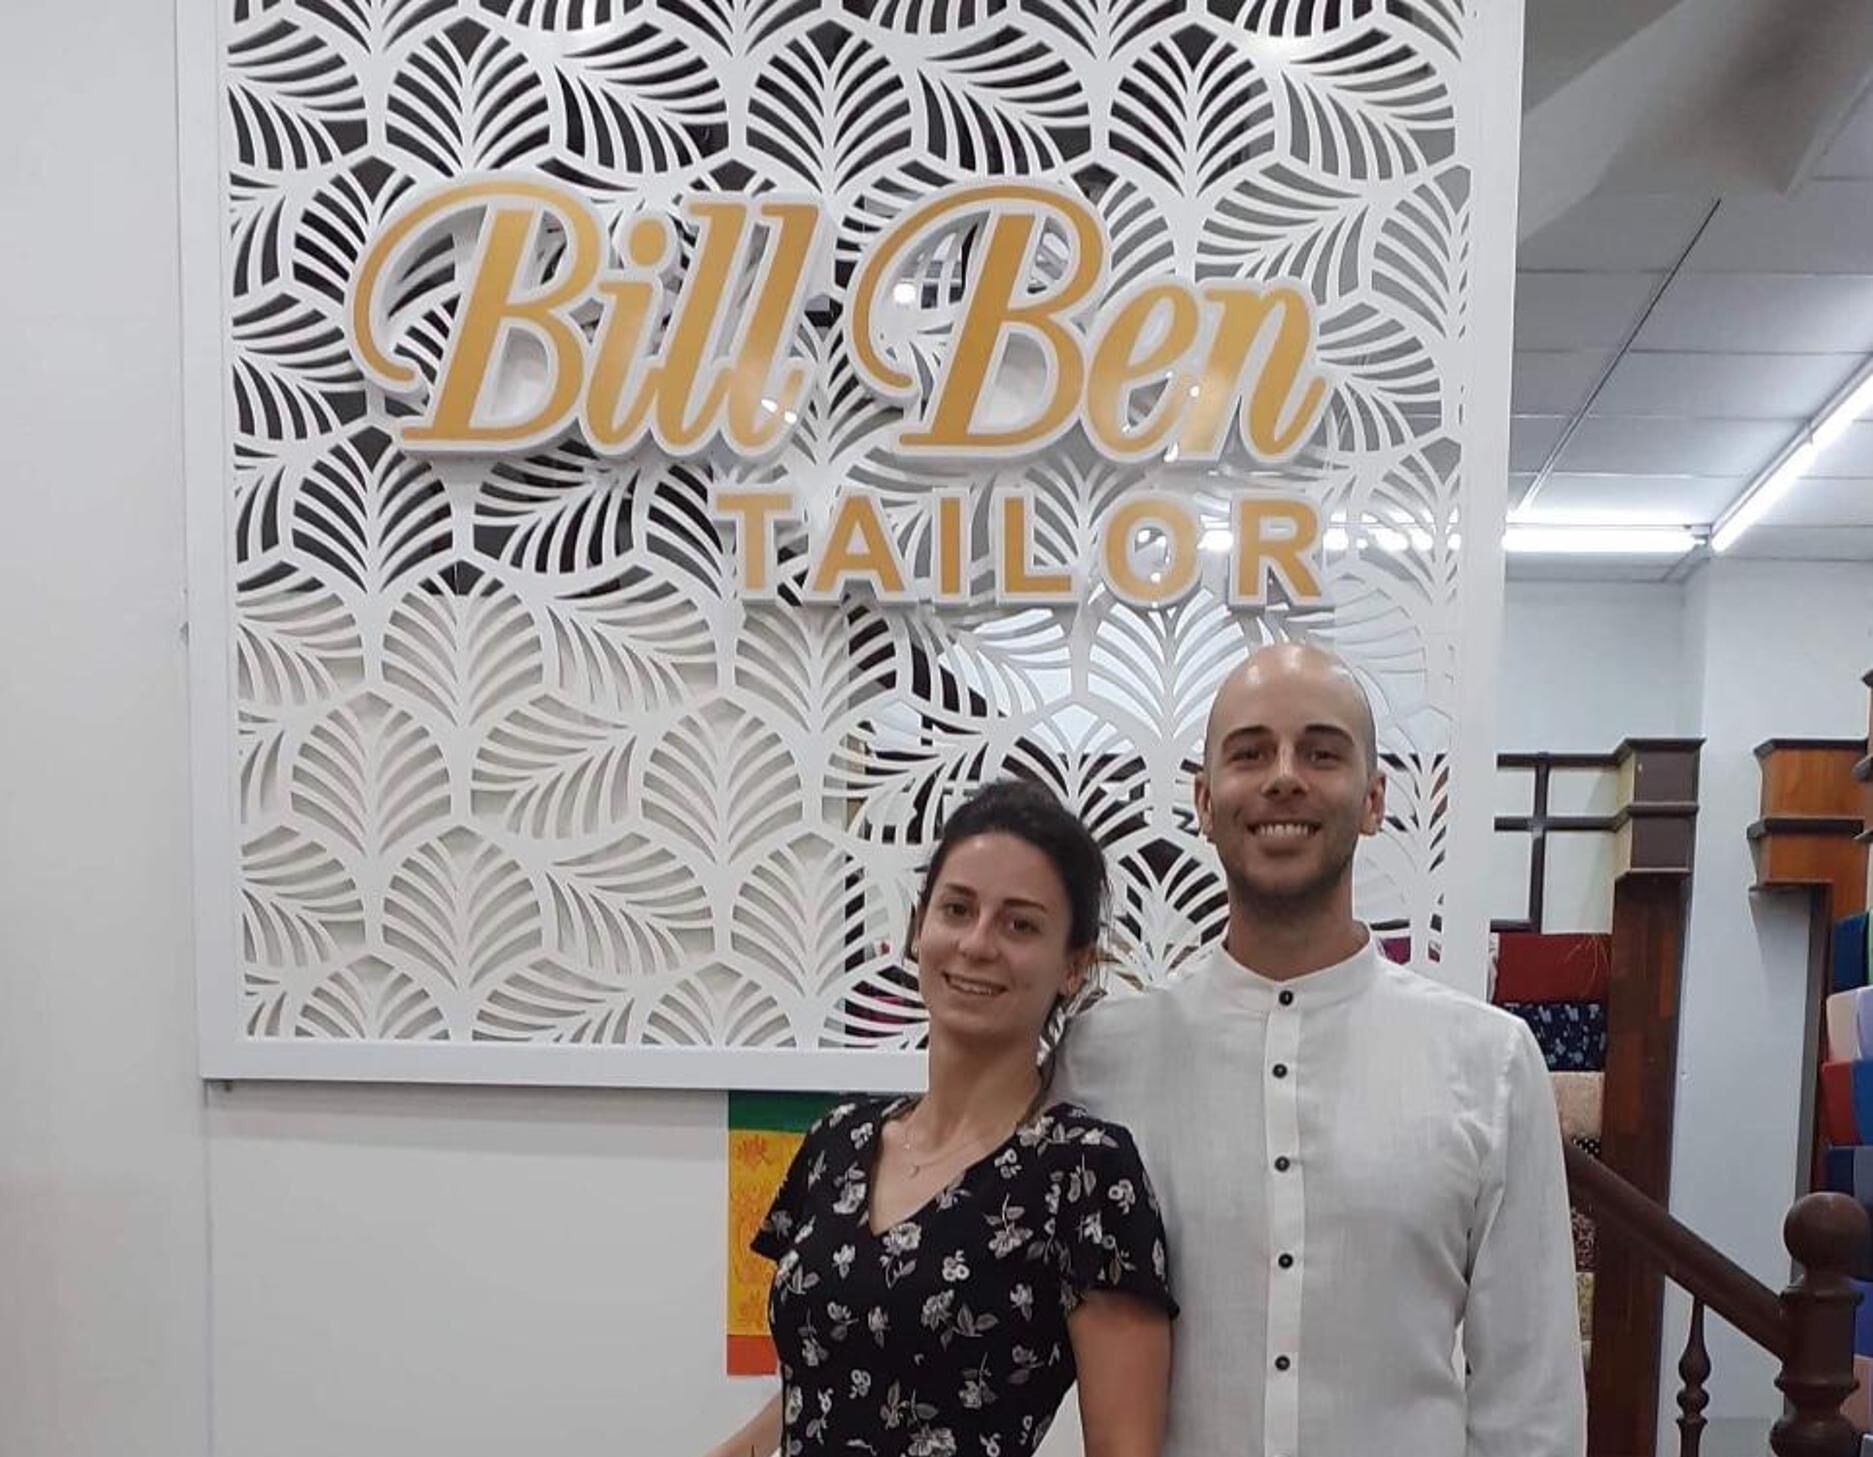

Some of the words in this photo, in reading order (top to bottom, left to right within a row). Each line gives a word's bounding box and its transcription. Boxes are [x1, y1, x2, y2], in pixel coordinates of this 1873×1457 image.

[351, 181, 822, 457] Bill
[850, 184, 1326, 460] Ben
[716, 492, 1323, 599] TAILOR
